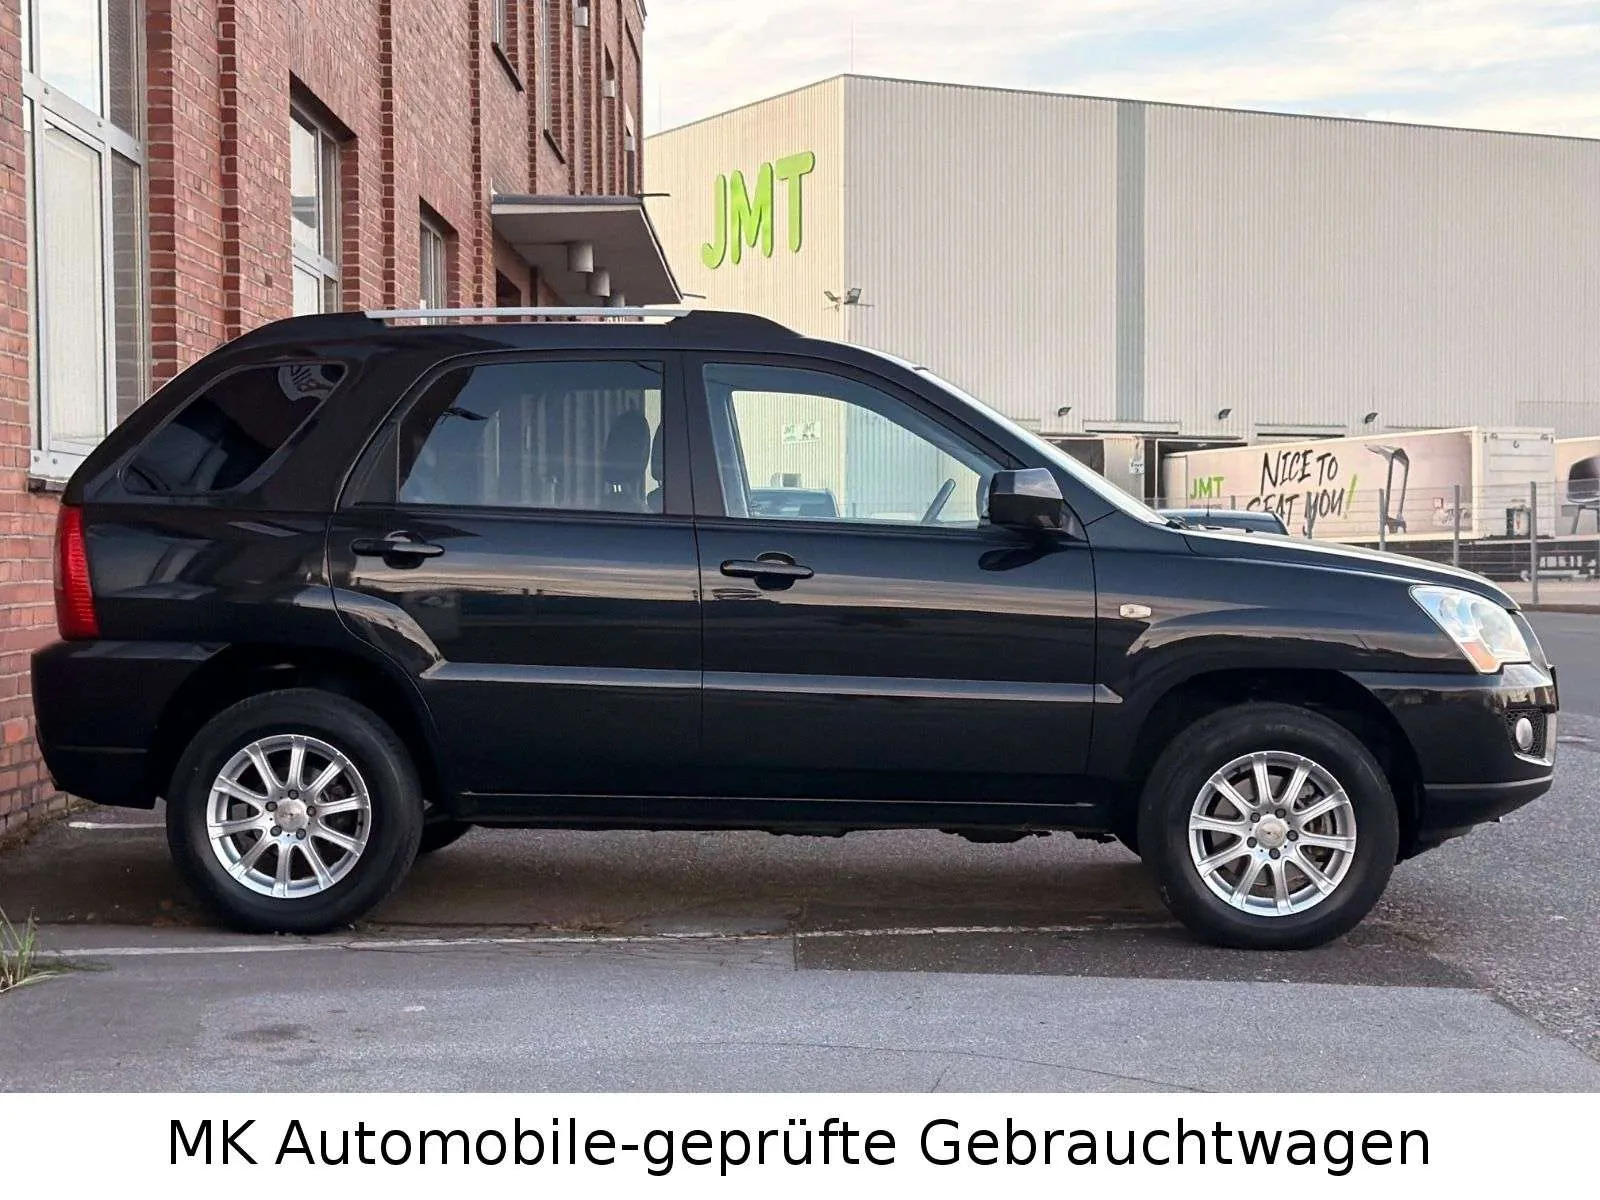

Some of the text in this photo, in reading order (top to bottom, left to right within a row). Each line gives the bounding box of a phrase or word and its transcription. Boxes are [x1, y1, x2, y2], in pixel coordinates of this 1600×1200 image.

[701, 151, 816, 270] JMT
[1189, 476, 1225, 499] JMT
[1260, 449, 1339, 496] NICE TO
